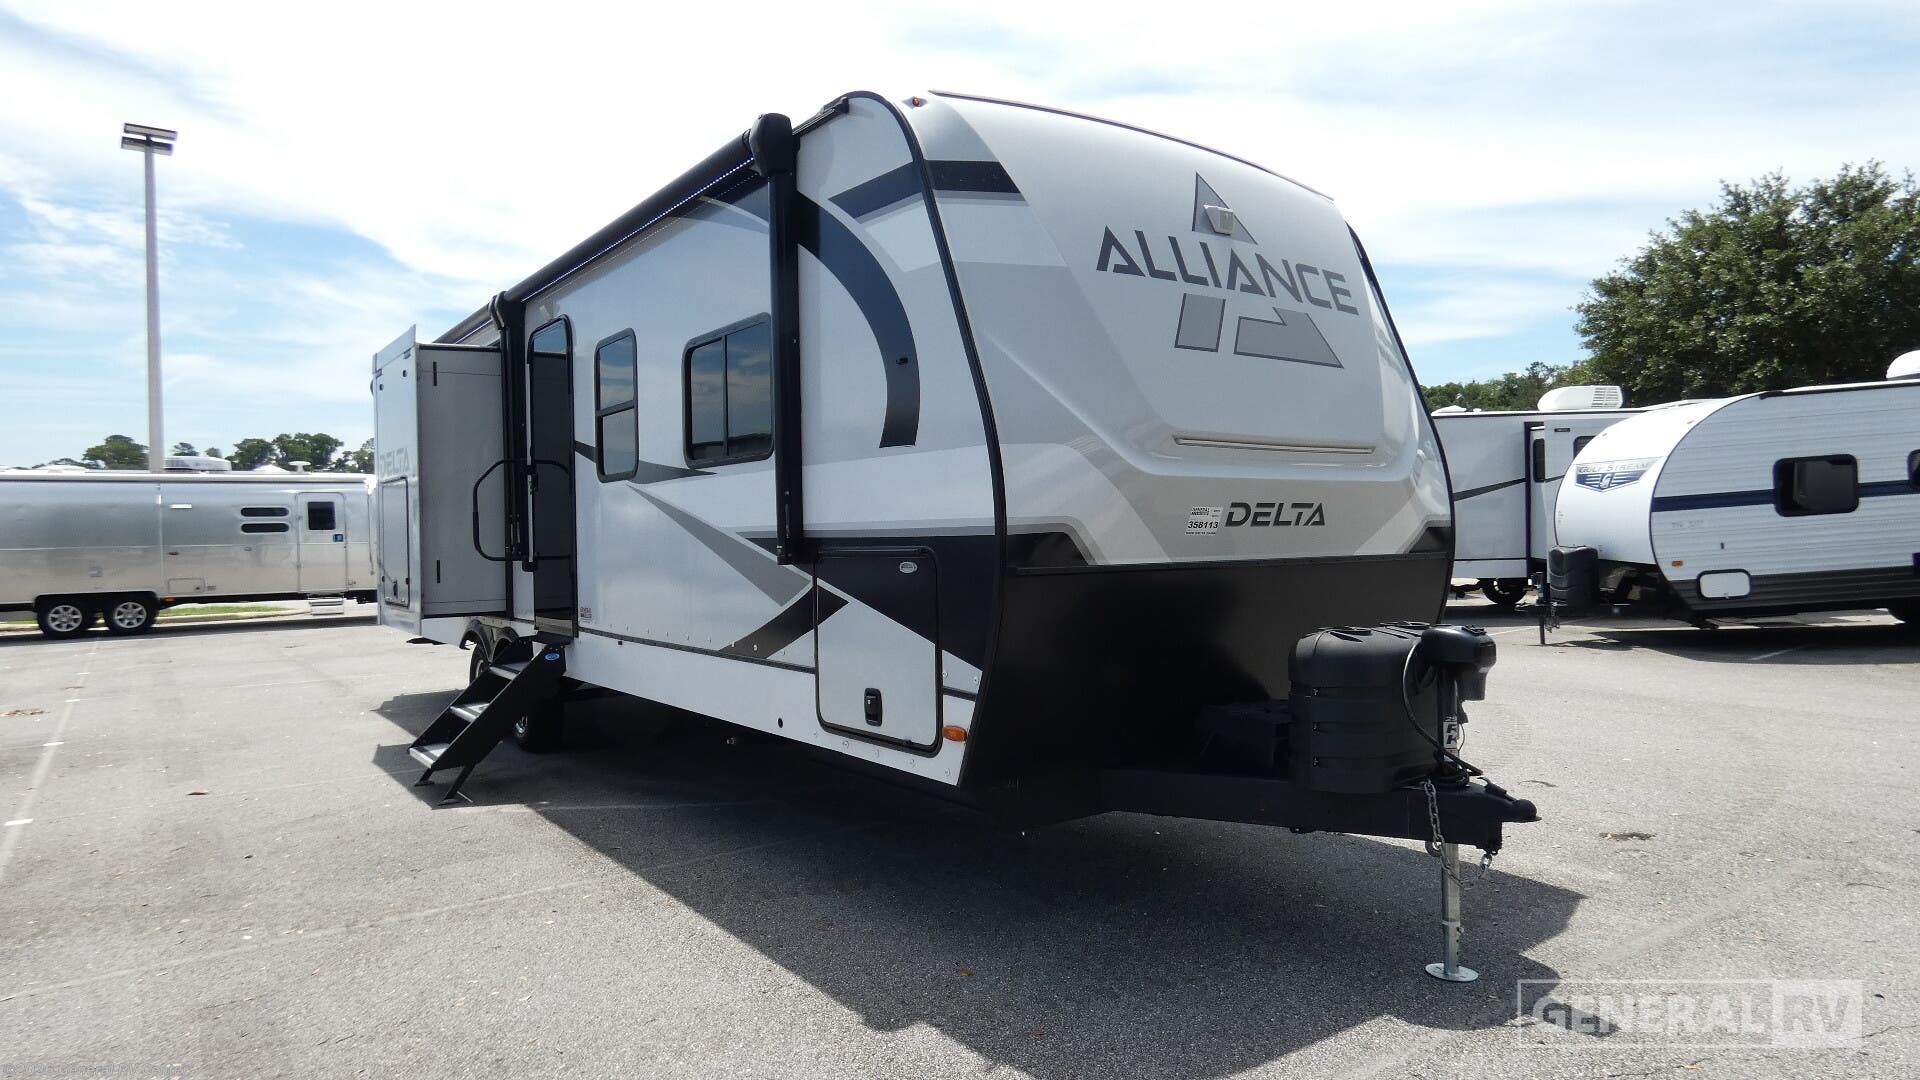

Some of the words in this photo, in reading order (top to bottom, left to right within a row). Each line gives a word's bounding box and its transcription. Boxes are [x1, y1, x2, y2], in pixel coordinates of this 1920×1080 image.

[1096, 225, 1359, 316] ALLIANCE
[1187, 520, 1219, 529] 358113
[1225, 502, 1325, 526] DELTA
